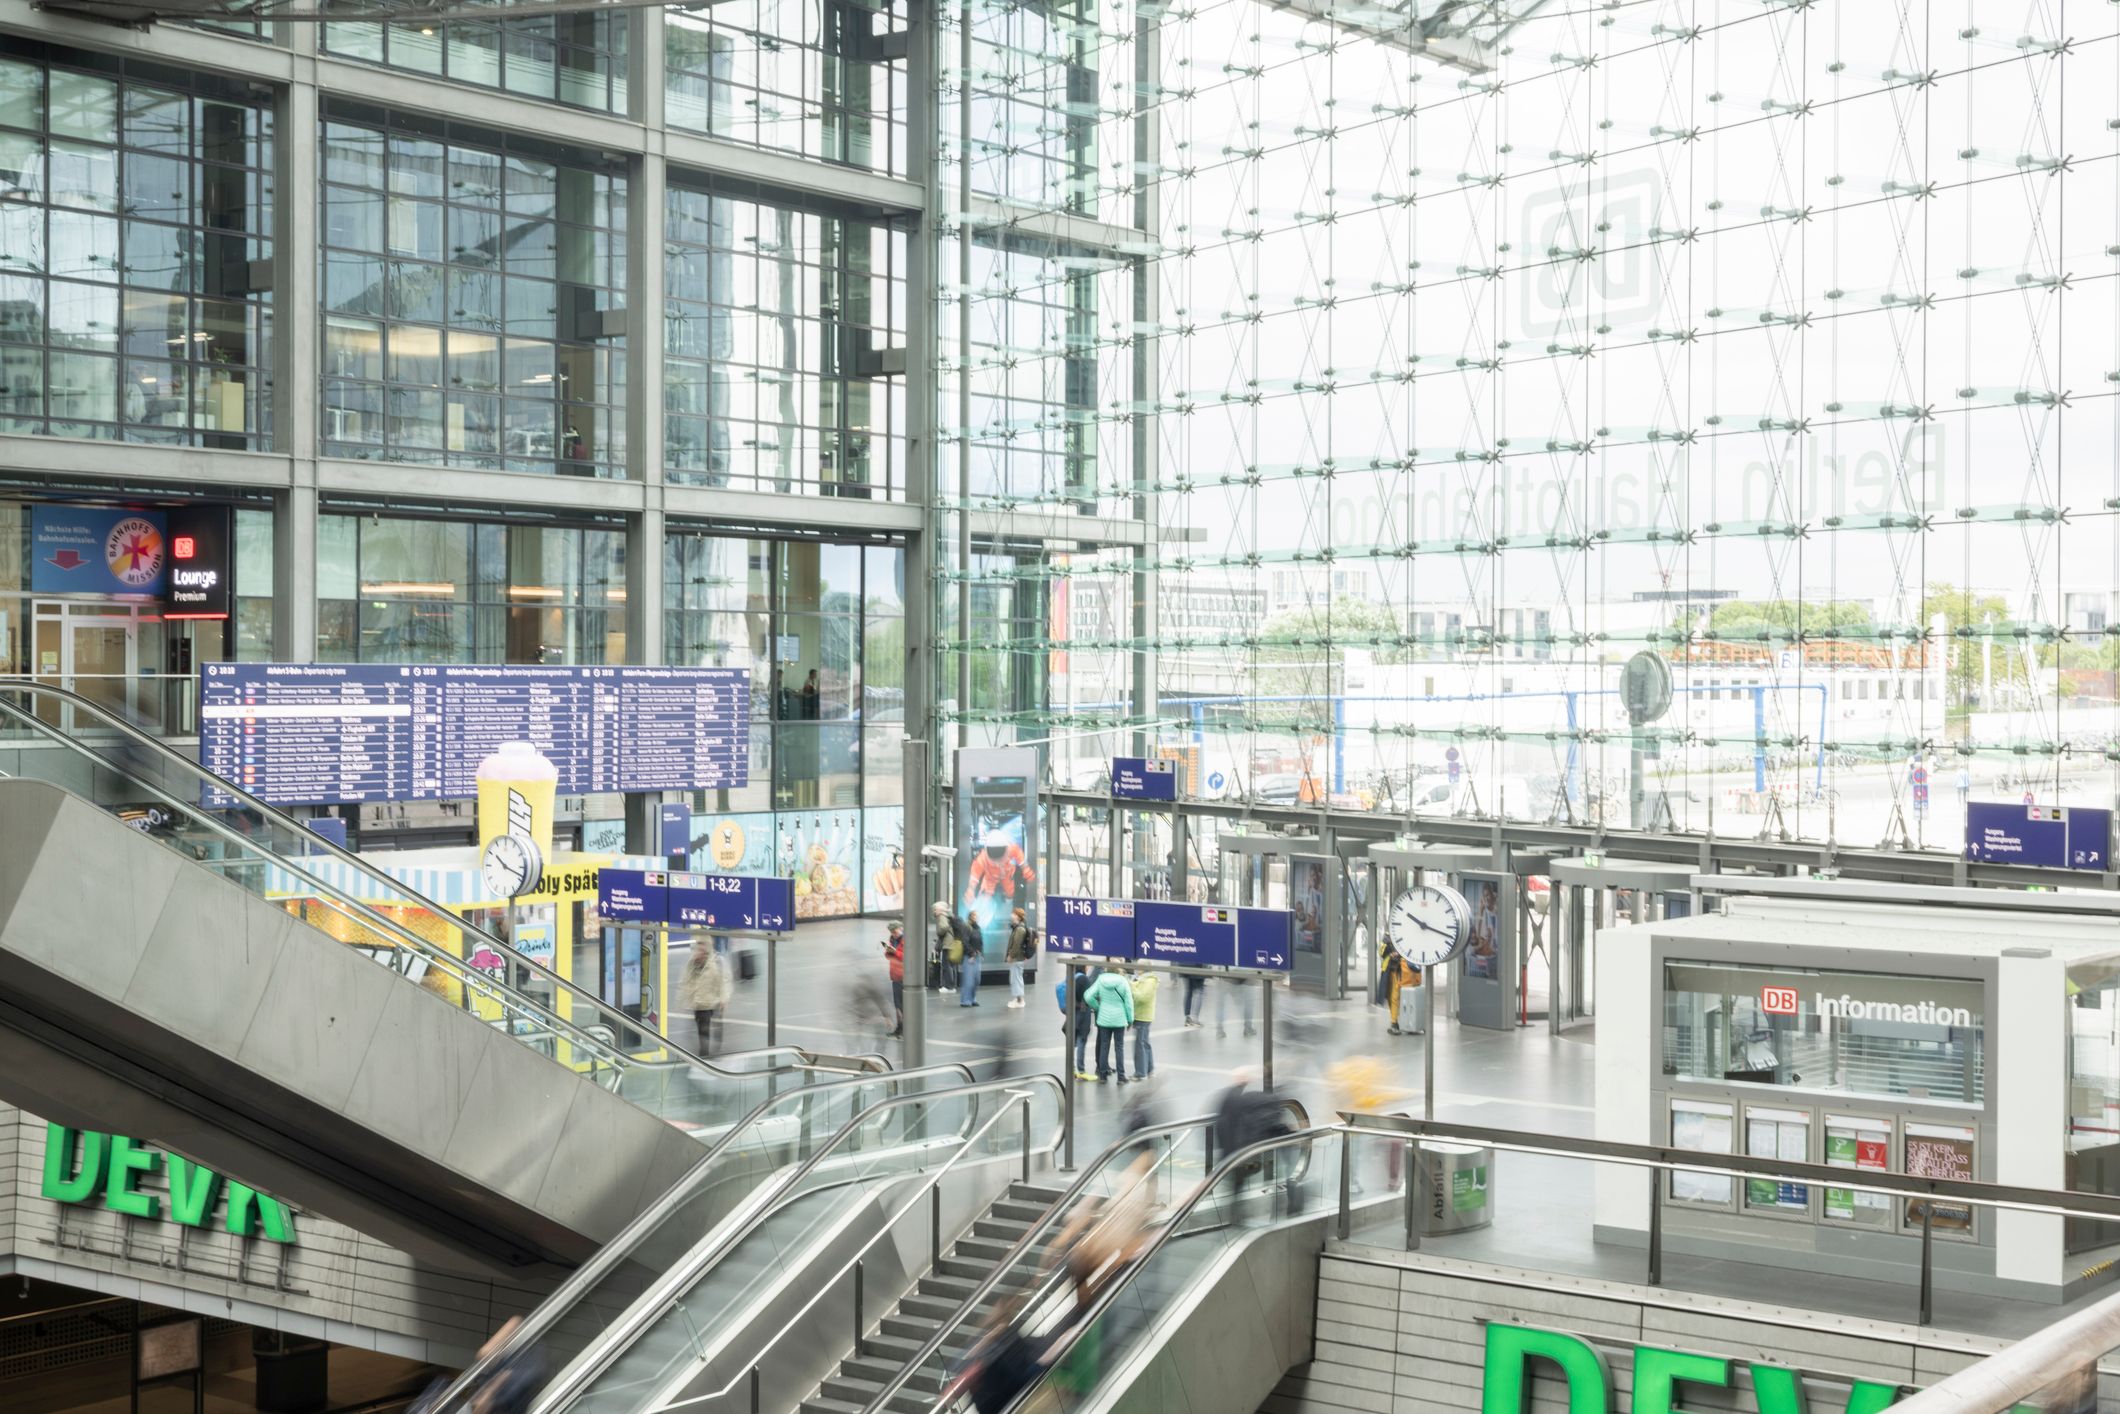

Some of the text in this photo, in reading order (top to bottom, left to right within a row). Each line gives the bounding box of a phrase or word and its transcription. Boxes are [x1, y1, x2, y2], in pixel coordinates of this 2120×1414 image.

[109, 521, 150, 558] BAHNHOFS
[177, 541, 191, 554] DB
[127, 553, 162, 584] MISSION
[174, 569, 216, 588] Lounge
[174, 591, 206, 602] Premium
[531, 874, 560, 896] oly
[673, 877, 680, 886] S
[690, 877, 697, 887] U
[709, 878, 741, 894] 1-8,22
[1063, 900, 1091, 916] 11-16
[1102, 902, 1111, 914] S
[1155, 927, 1176, 936] Ausgang
[1257, 955, 1266, 964] WC
[1766, 992, 1794, 1011] DB
[1815, 992, 1970, 1026] Information
[1934, 1144, 1954, 1154] KEIN
[1944, 1153, 1968, 1164] DASS
[1434, 1173, 1444, 1219] Abfall
